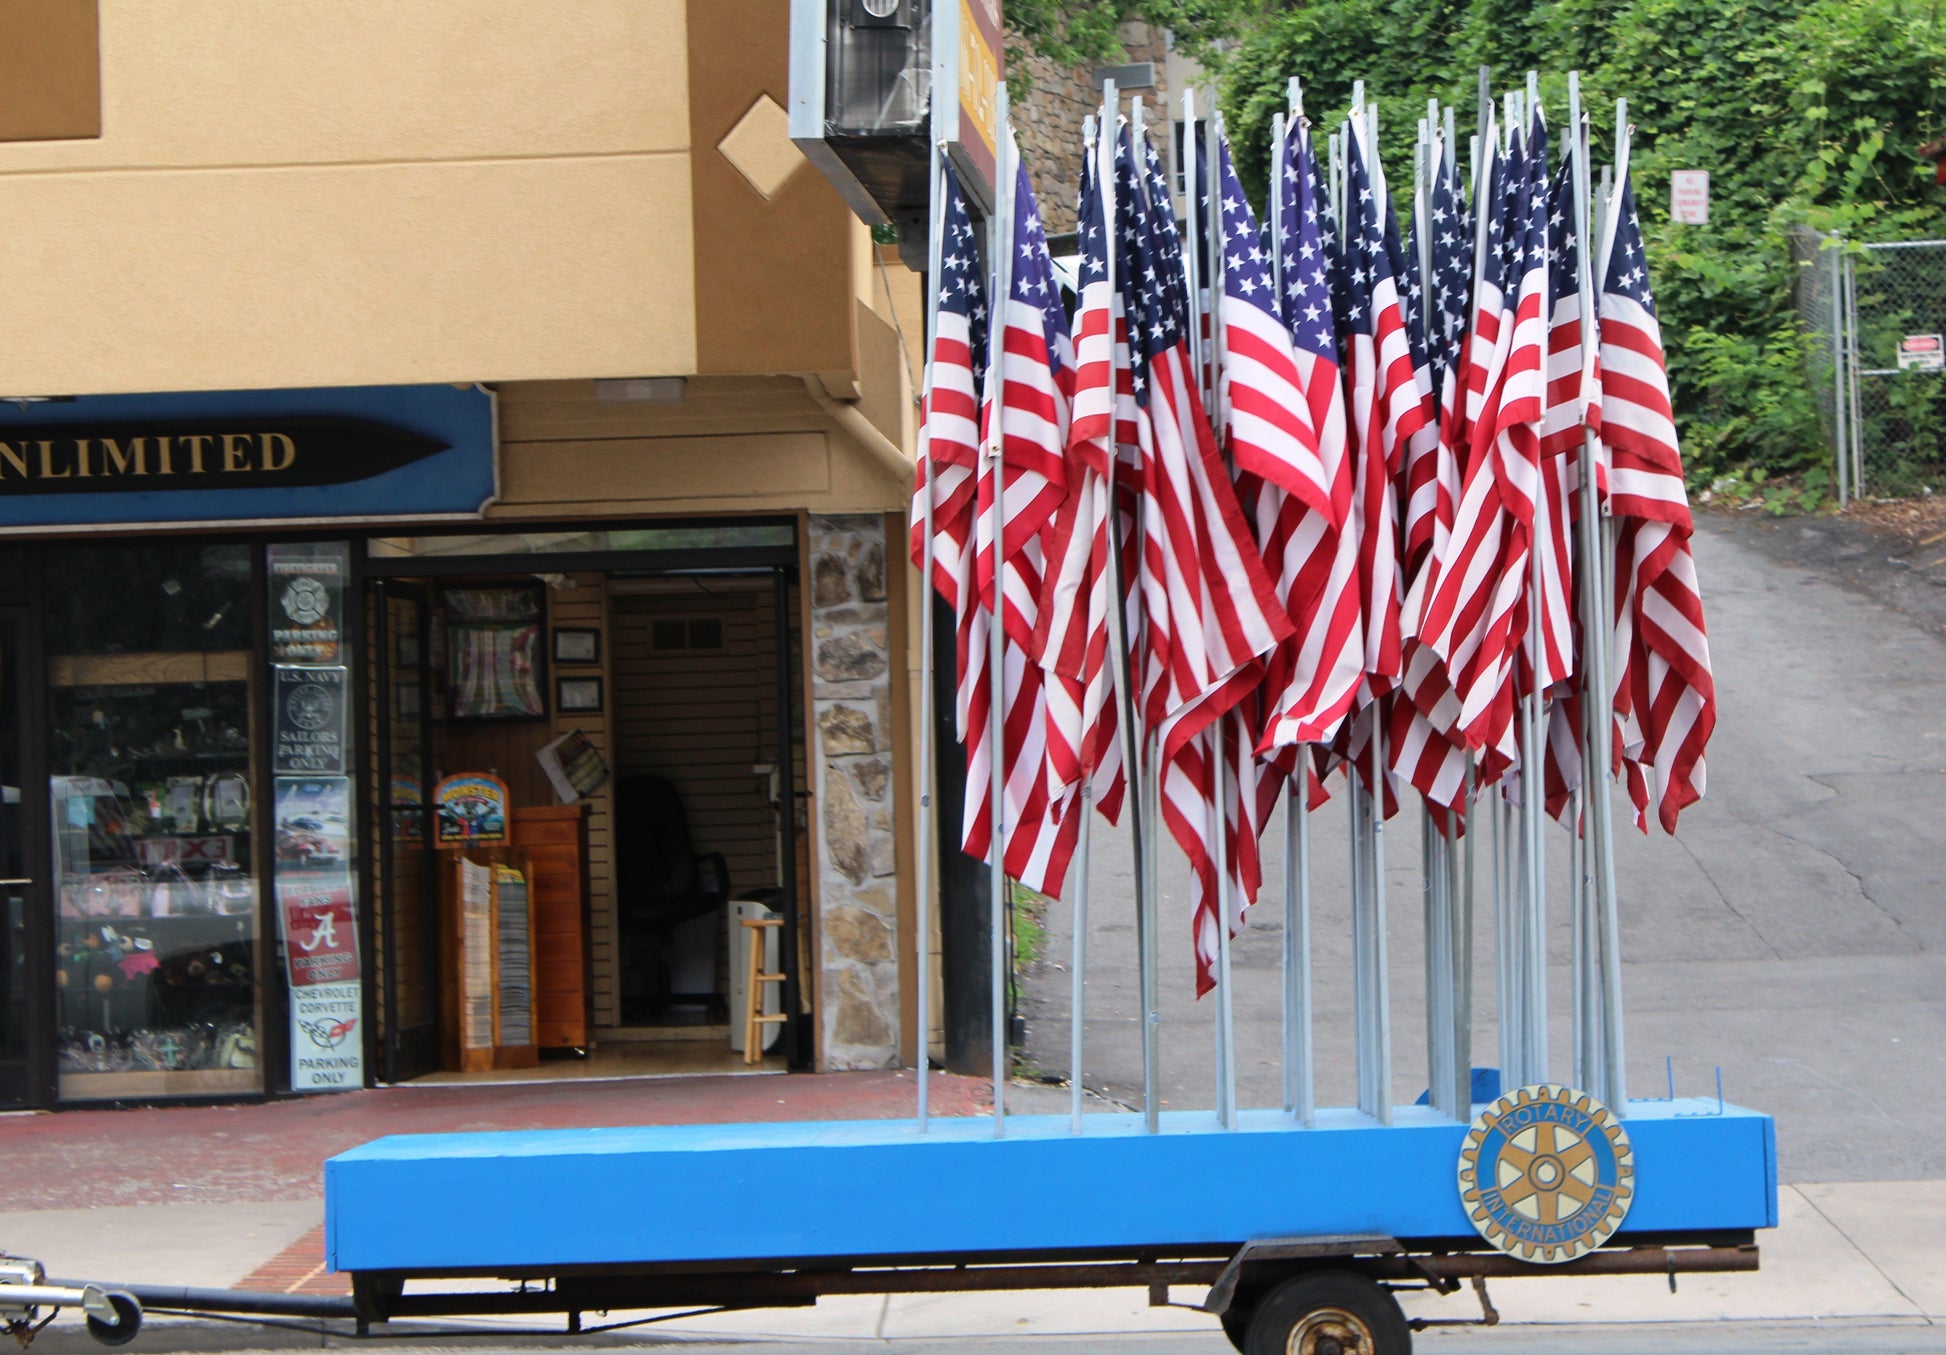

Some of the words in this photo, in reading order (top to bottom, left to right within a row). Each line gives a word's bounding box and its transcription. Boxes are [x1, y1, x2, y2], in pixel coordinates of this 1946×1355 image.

[273, 629, 338, 642] PARKING
[287, 645, 324, 657] ONLY
[306, 671, 340, 682] NAVY
[280, 731, 338, 742] SAILORS
[279, 744, 340, 757] PARKING
[290, 758, 327, 769] ONLY
[300, 895, 332, 907] FANS
[293, 952, 353, 969] PARKING
[306, 967, 343, 980] ONLY
[295, 987, 359, 999] CHEVROLET
[299, 1002, 356, 1014] CORVETTE
[298, 1056, 359, 1070] PARKING
[311, 1072, 345, 1084] ONLY
[1500, 1102, 1591, 1134] ROTARY
[1482, 1190, 1613, 1243] INTERNATIONAL
